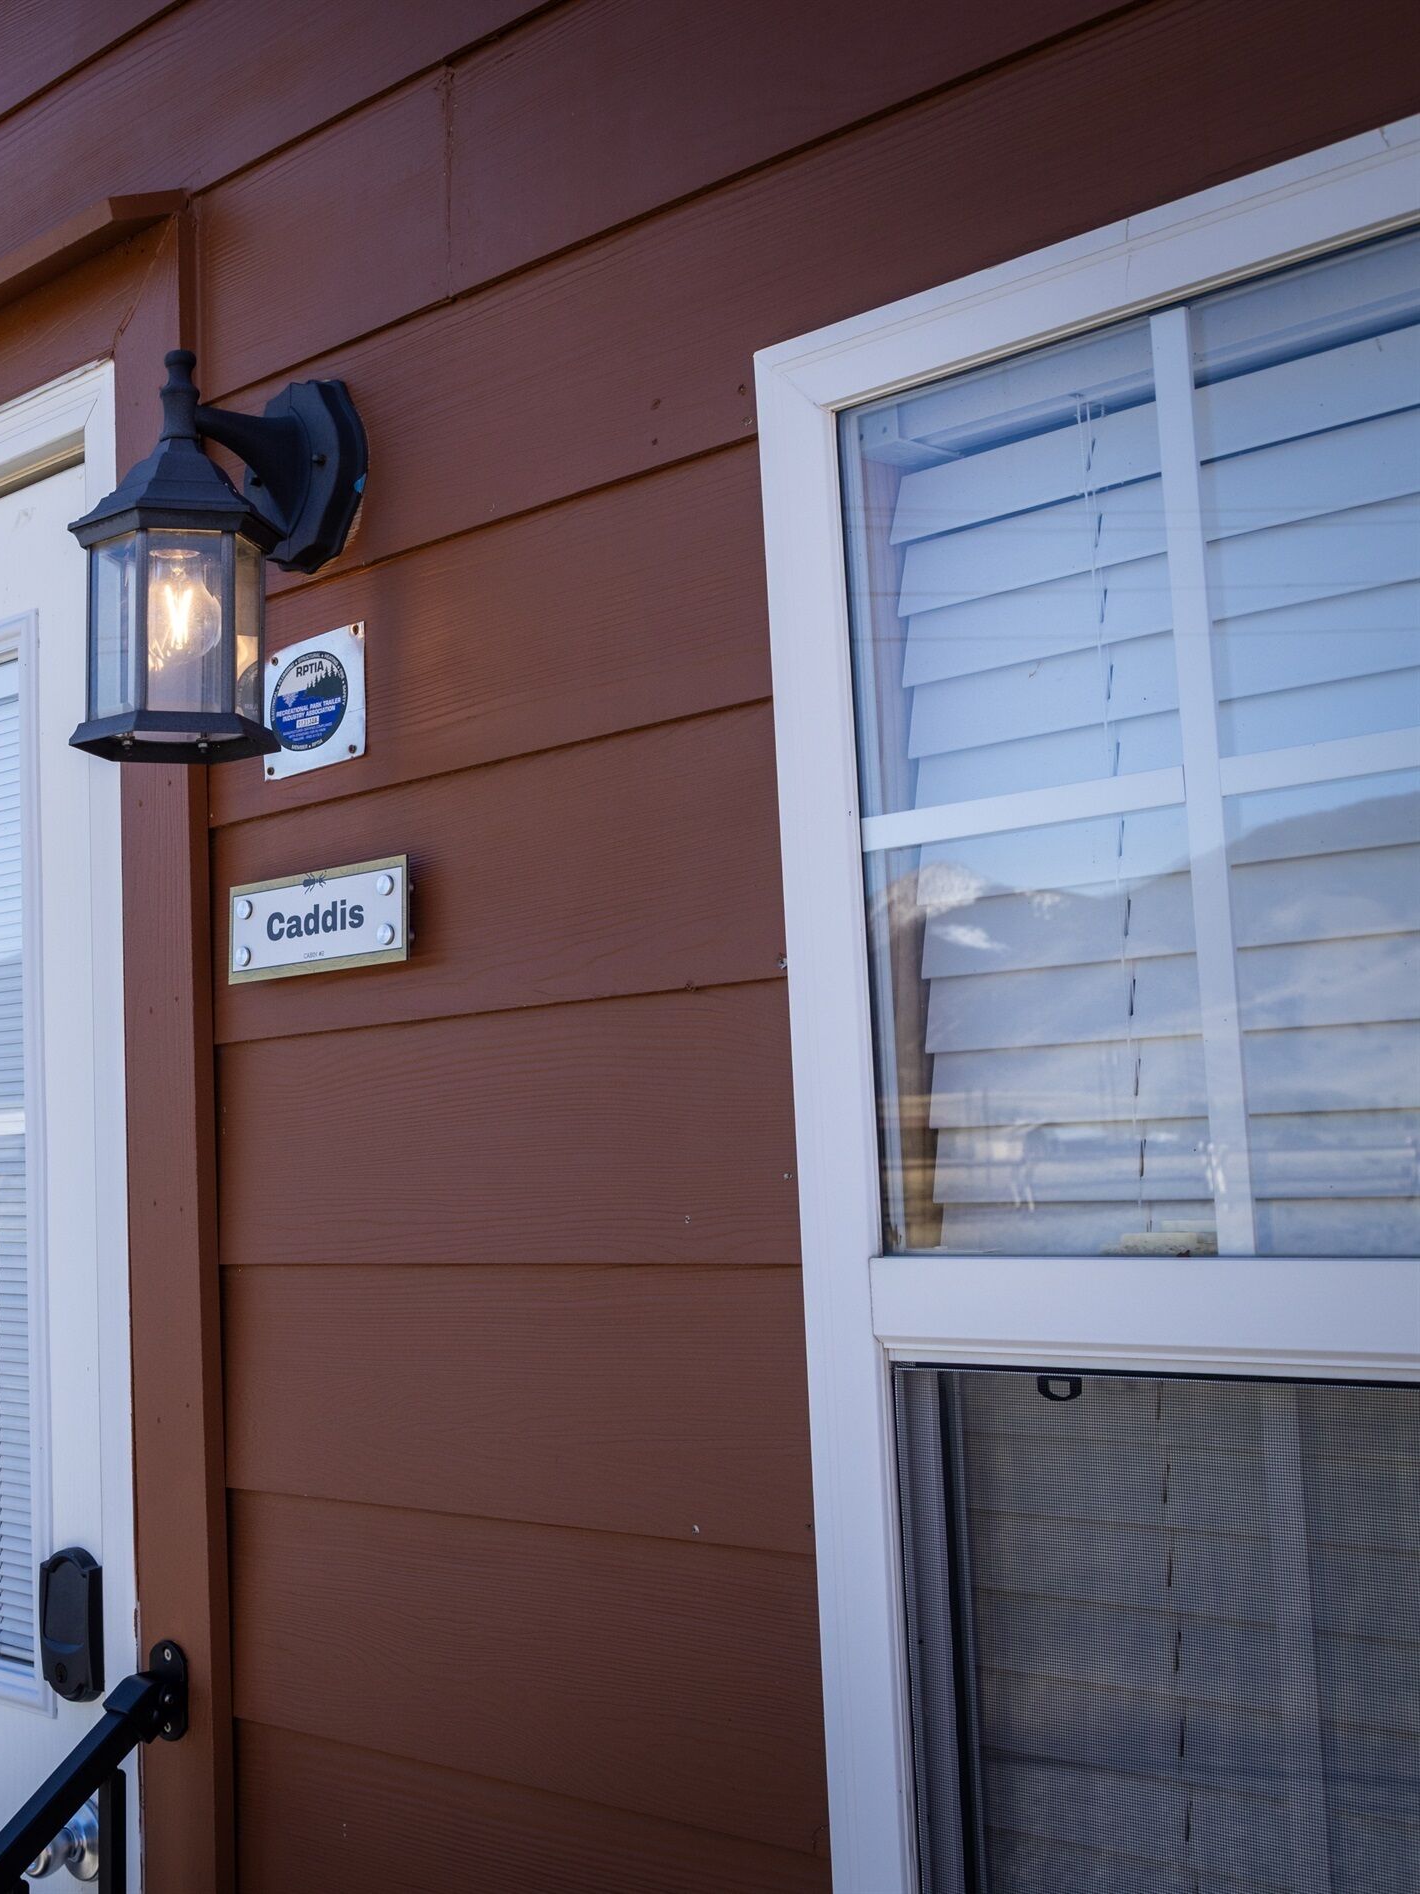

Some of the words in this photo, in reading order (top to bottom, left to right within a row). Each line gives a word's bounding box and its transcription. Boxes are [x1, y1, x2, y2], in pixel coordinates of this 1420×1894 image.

[296, 661, 324, 677] RPTIA
[276, 705, 309, 718] RECREATIONAL
[309, 701, 323, 710] PARK
[323, 697, 342, 706] TRAILER
[282, 712, 305, 722] INDUSTRY
[305, 705, 336, 717] ASSOCIATION
[267, 899, 364, 941] Caddis
